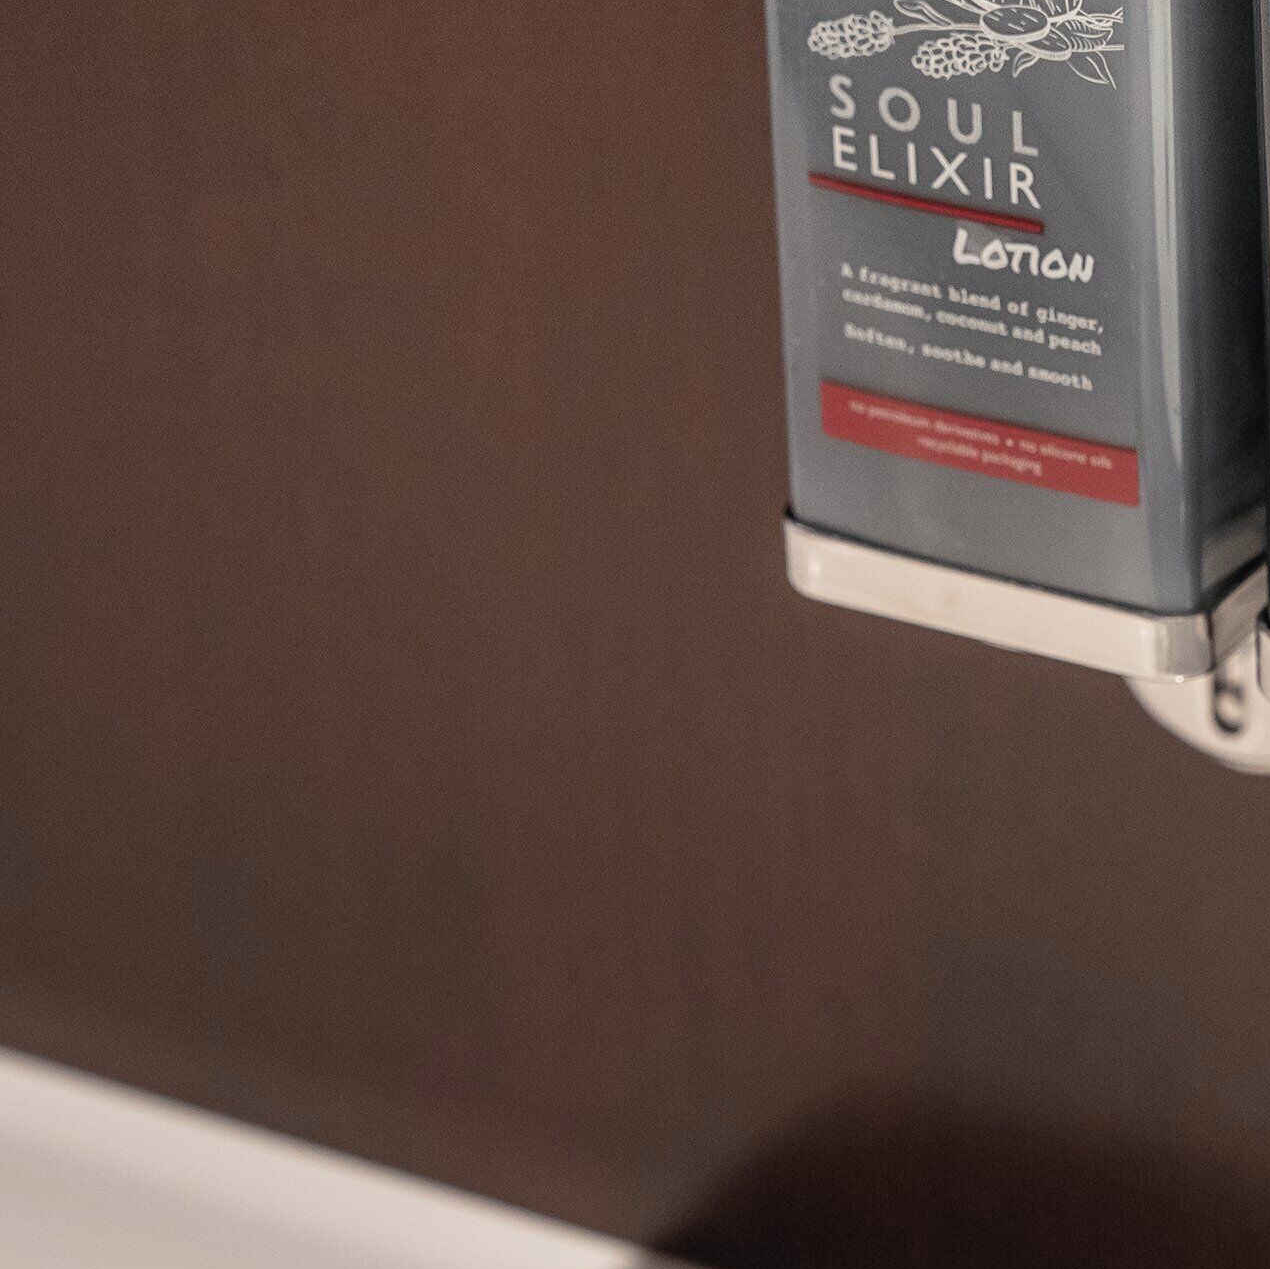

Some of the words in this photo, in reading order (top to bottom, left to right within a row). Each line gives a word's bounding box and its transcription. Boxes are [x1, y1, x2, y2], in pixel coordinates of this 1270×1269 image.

[829, 74, 1040, 158] SOUL
[831, 125, 1042, 210] ELIXIR
[953, 227, 1095, 283] LOTION
[841, 261, 854, 279] A
[948, 284, 1001, 311] blend
[1007, 300, 1030, 318] of
[1036, 306, 1104, 335] ginger,
[1012, 326, 1045, 344] and
[1048, 334, 1102, 357] peach
[990, 358, 1024, 377] and
[1028, 366, 1094, 391] smooth
